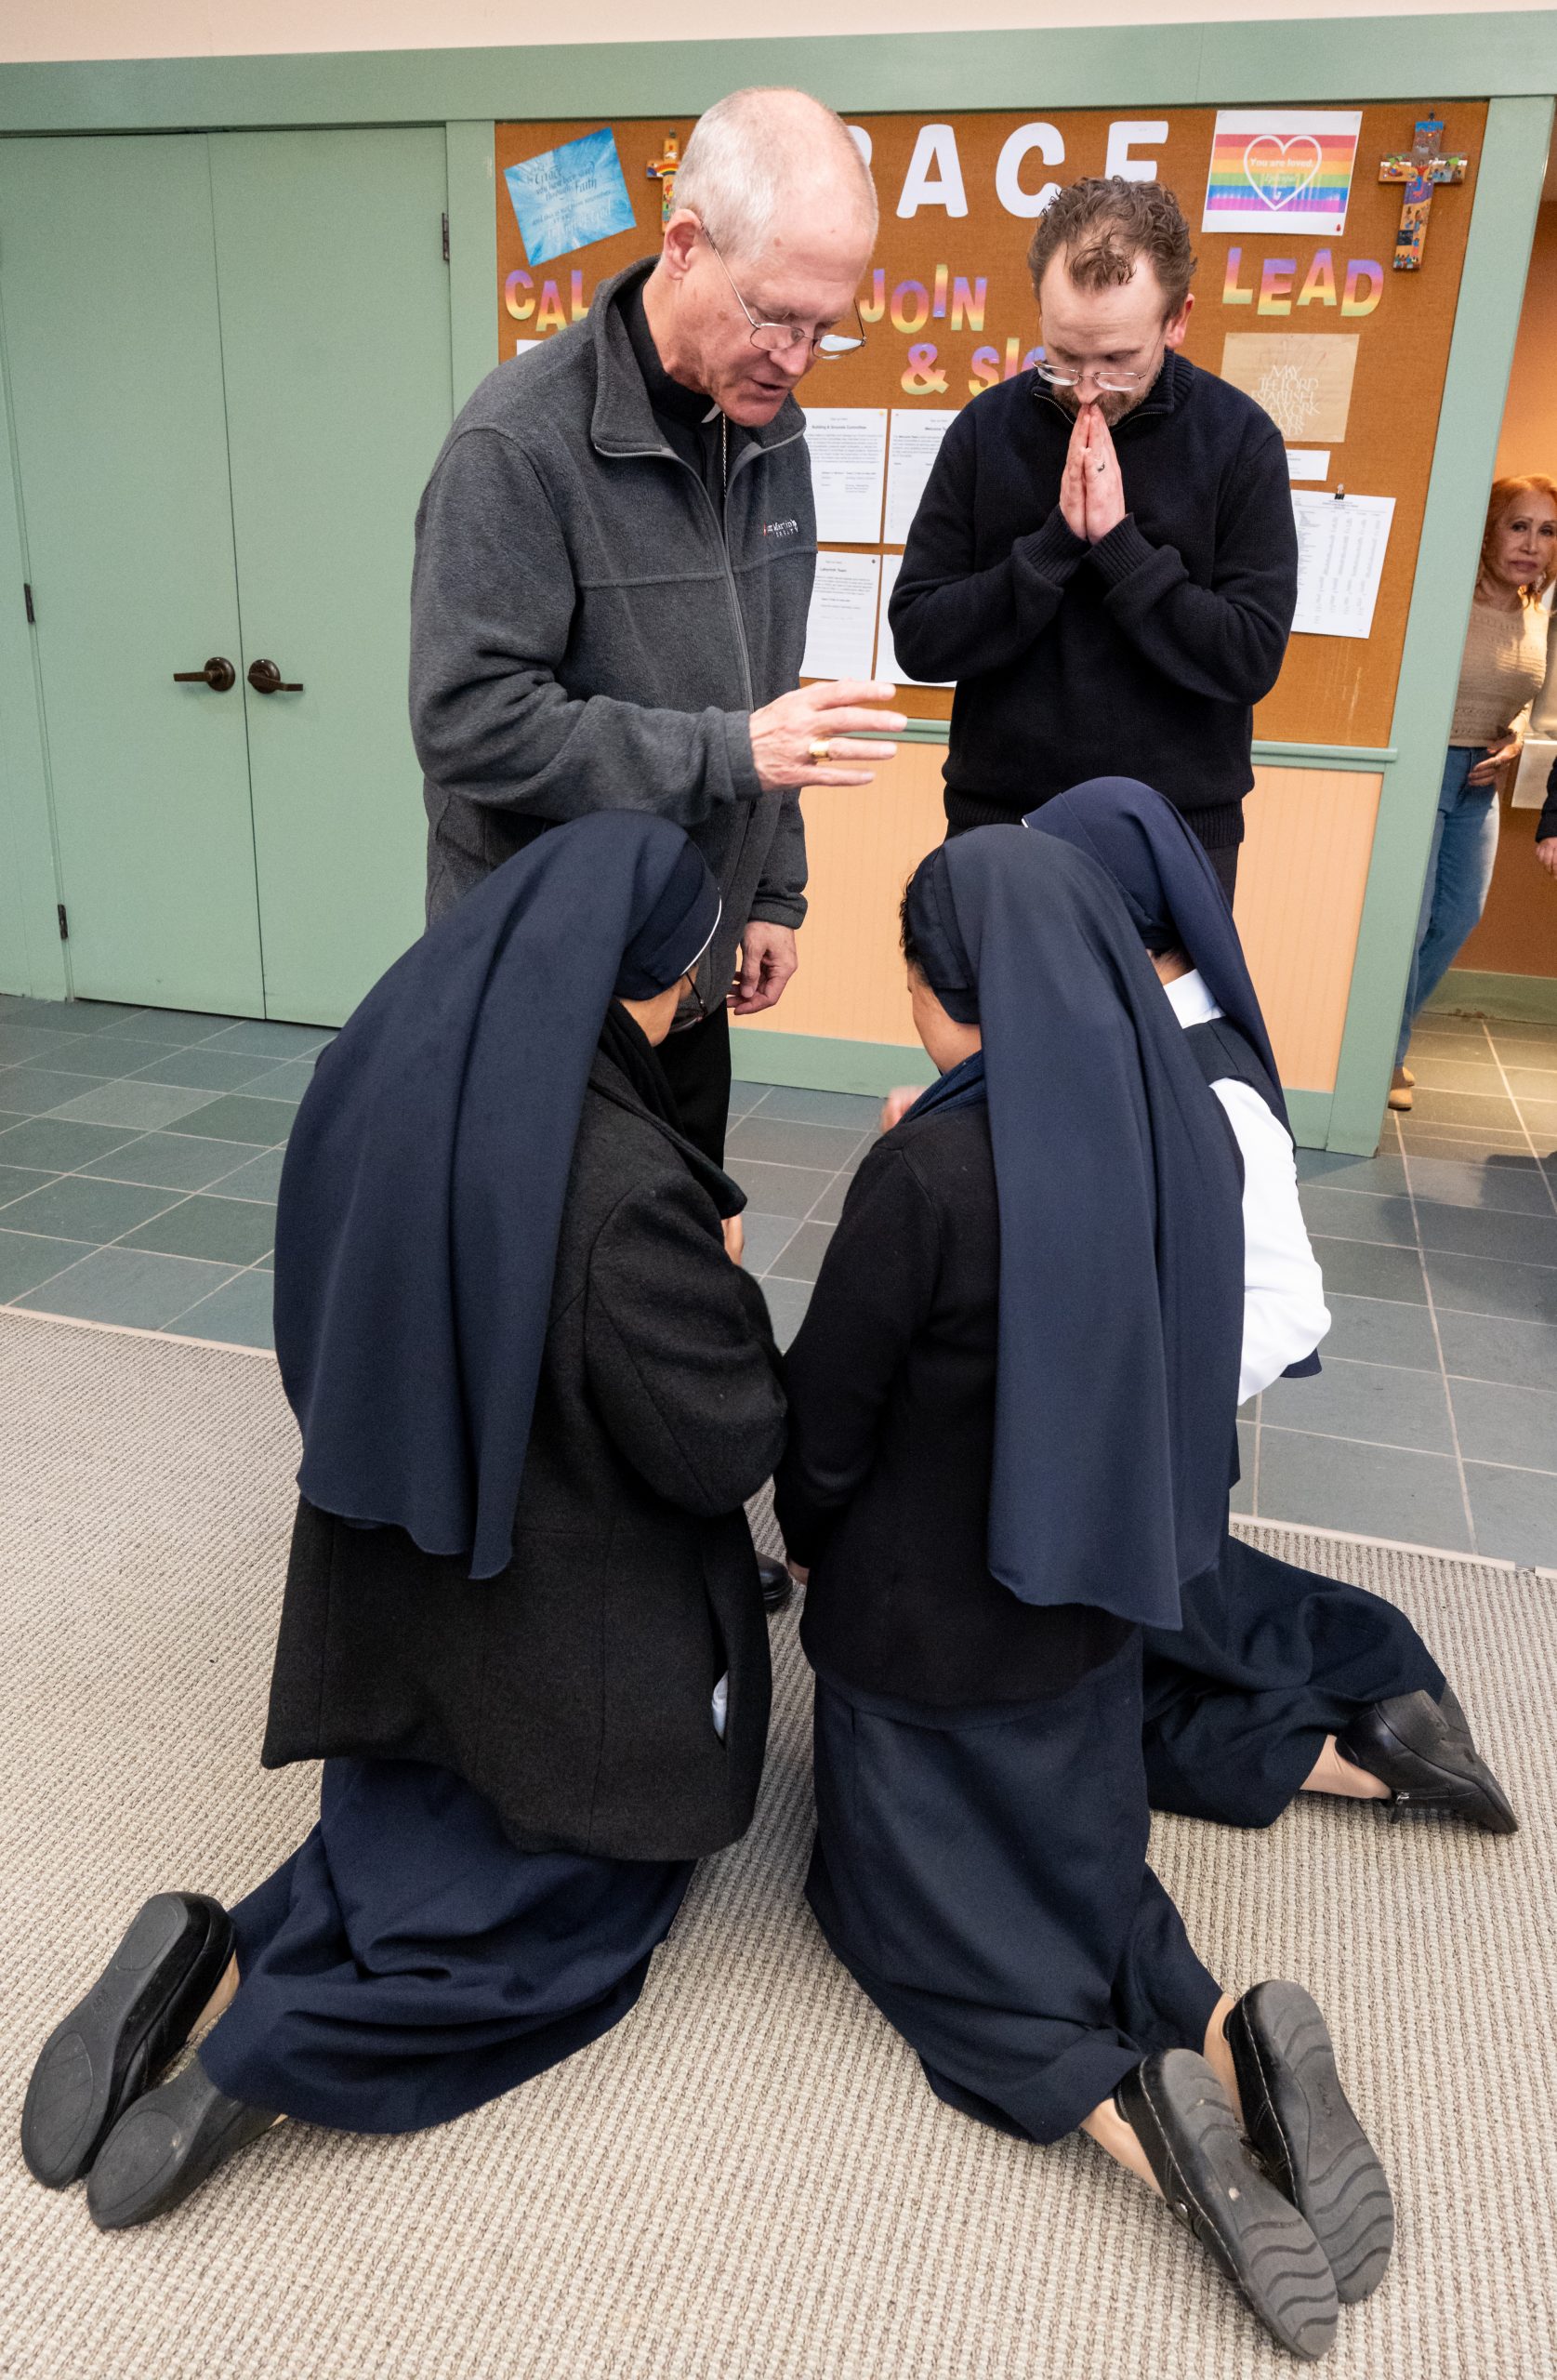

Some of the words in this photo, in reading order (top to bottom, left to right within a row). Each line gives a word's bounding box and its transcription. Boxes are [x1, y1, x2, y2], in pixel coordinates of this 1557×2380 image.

[838, 121, 1168, 218] ACE
[859, 263, 987, 335] JOIN
[1222, 246, 1384, 317] LEAD
[900, 342, 950, 395] &
[1270, 364, 1302, 380] MAY
[1280, 377, 1319, 393] LORD
